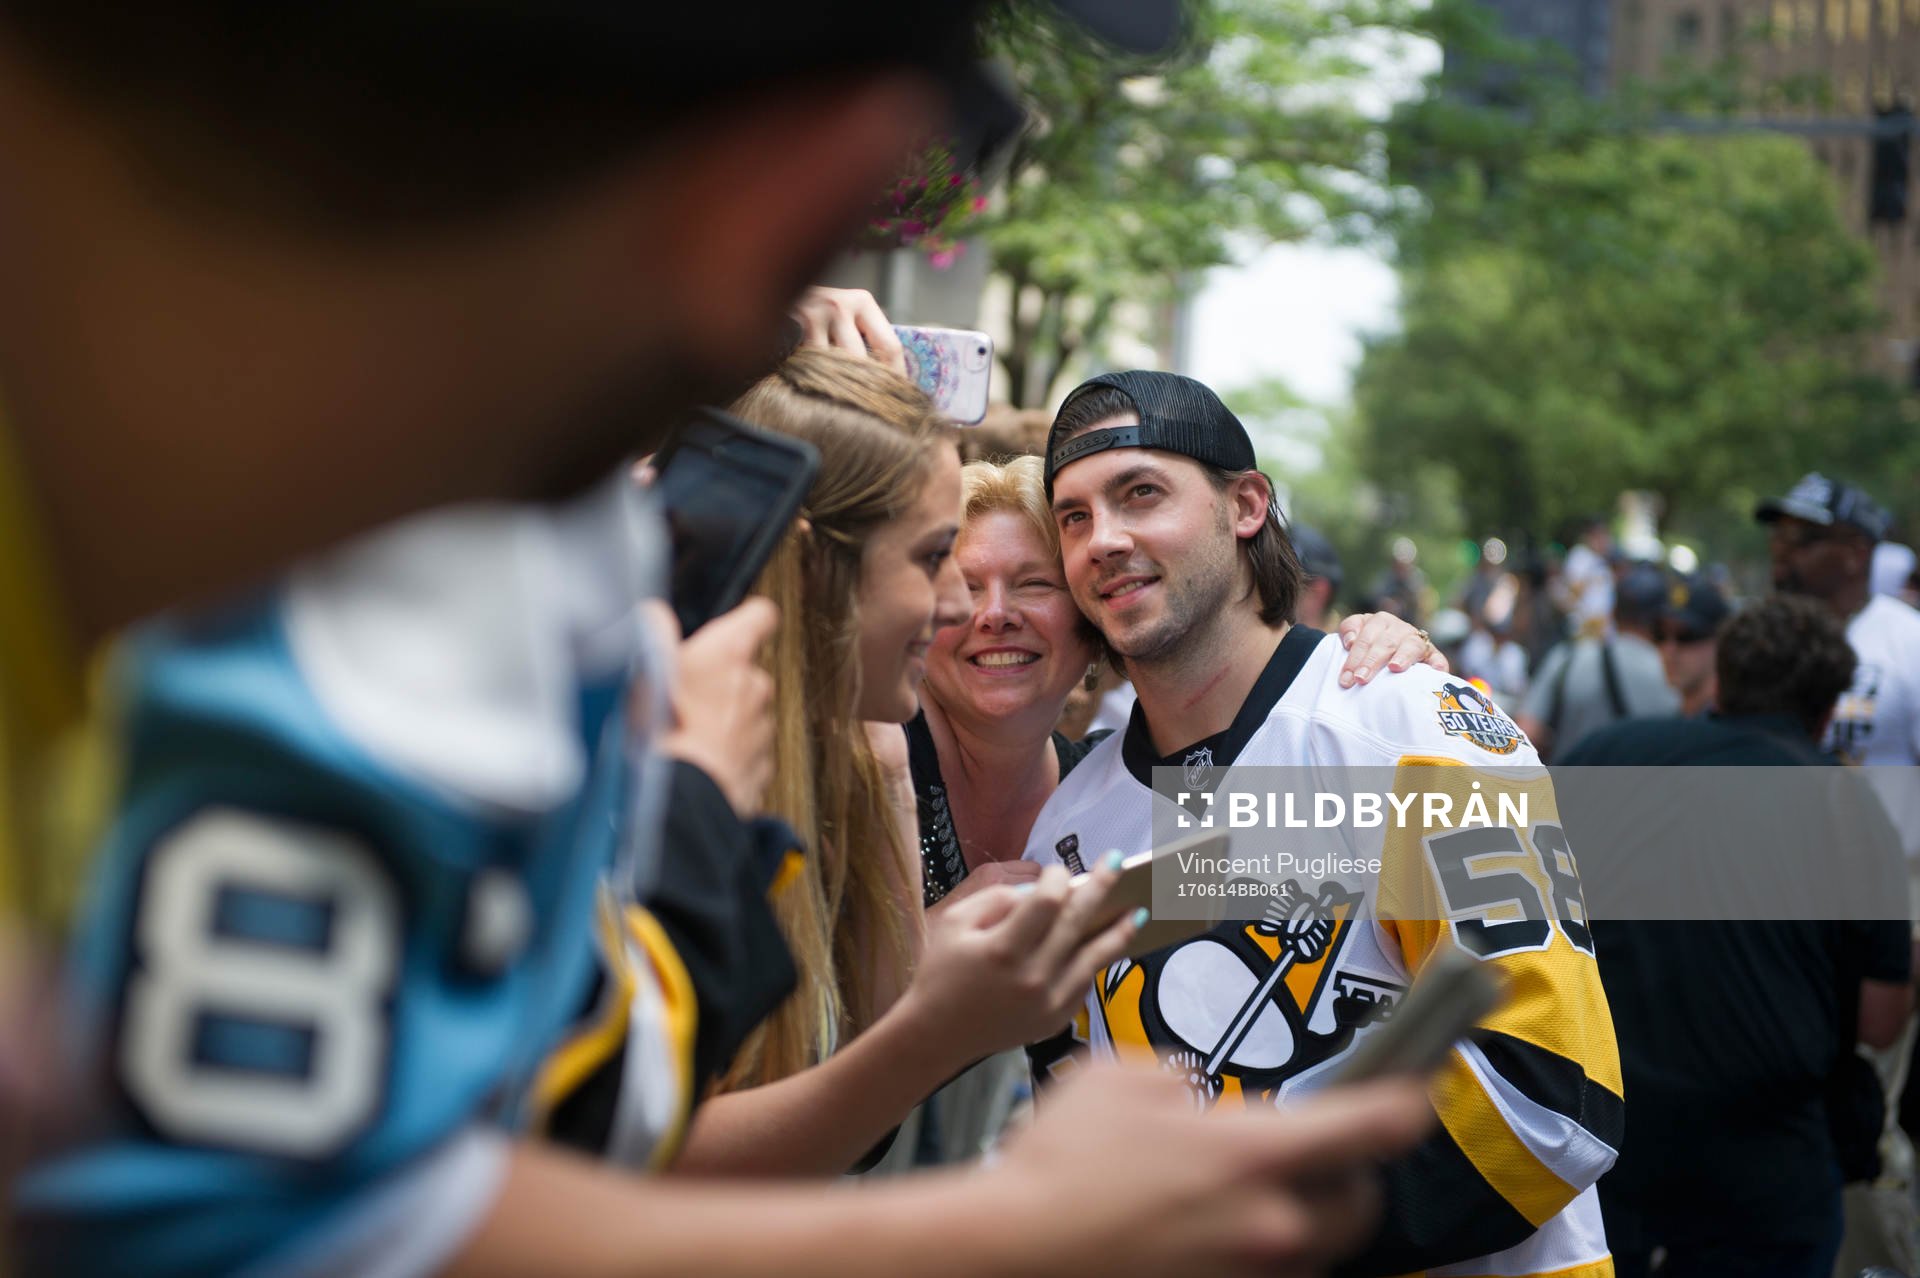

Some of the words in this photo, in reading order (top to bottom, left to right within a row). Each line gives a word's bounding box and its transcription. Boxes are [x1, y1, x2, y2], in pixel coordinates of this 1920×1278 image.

[1440, 711, 1468, 731] 50
[1466, 713, 1519, 738] YEARS
[1422, 822, 1597, 960] 58
[120, 806, 402, 1160] 8
